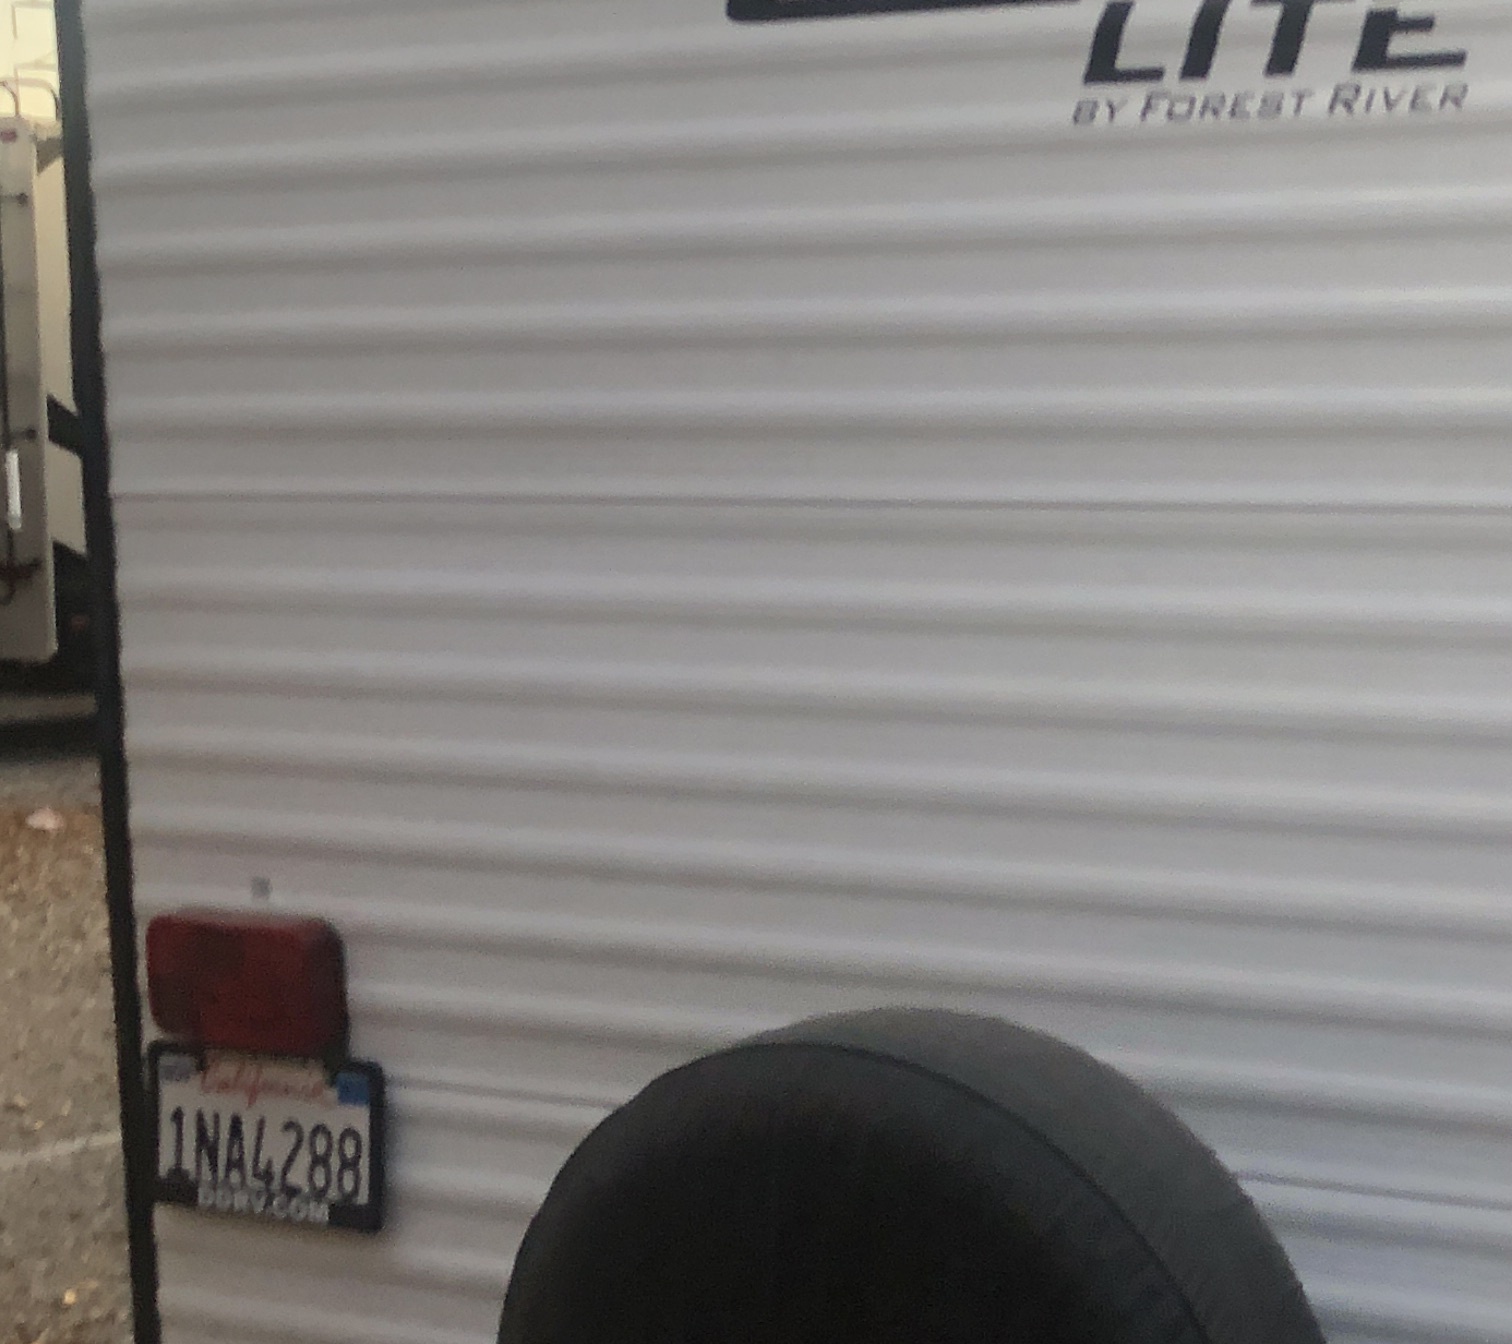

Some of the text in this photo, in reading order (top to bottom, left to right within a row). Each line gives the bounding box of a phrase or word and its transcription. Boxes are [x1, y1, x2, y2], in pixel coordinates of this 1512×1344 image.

[1072, 83, 1469, 125] BY FOREST RIVER
[170, 1105, 363, 1202] 1NA4288
